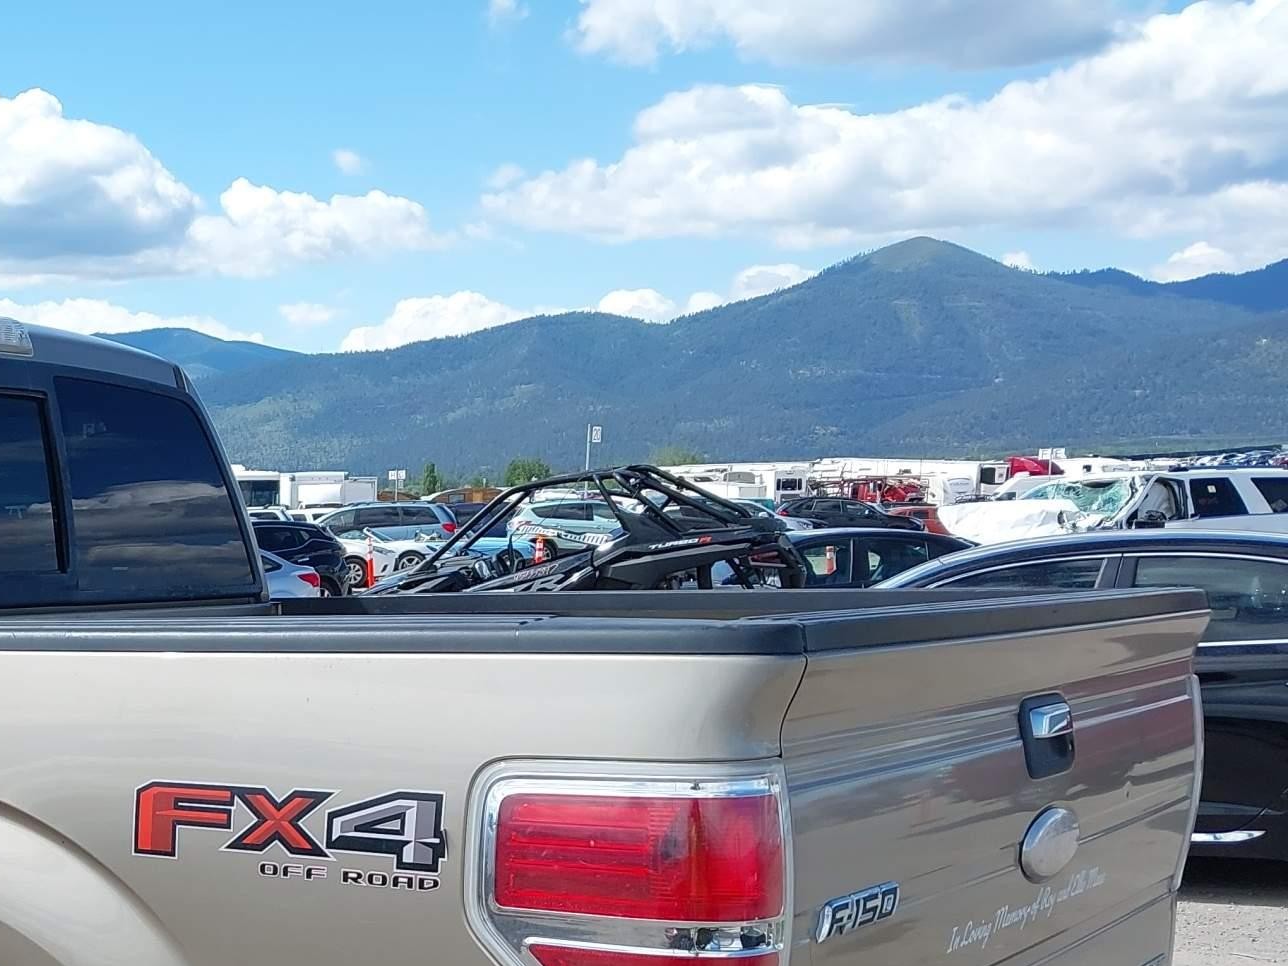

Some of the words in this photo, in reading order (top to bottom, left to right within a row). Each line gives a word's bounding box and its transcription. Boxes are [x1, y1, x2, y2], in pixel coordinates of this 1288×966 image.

[132, 779, 448, 873] FX4
[258, 862, 327, 881] OFF
[341, 869, 441, 891] ROAD
[946, 926, 961, 954] In
[960, 920, 993, 949] Loving
[993, 904, 1030, 931] Memory
